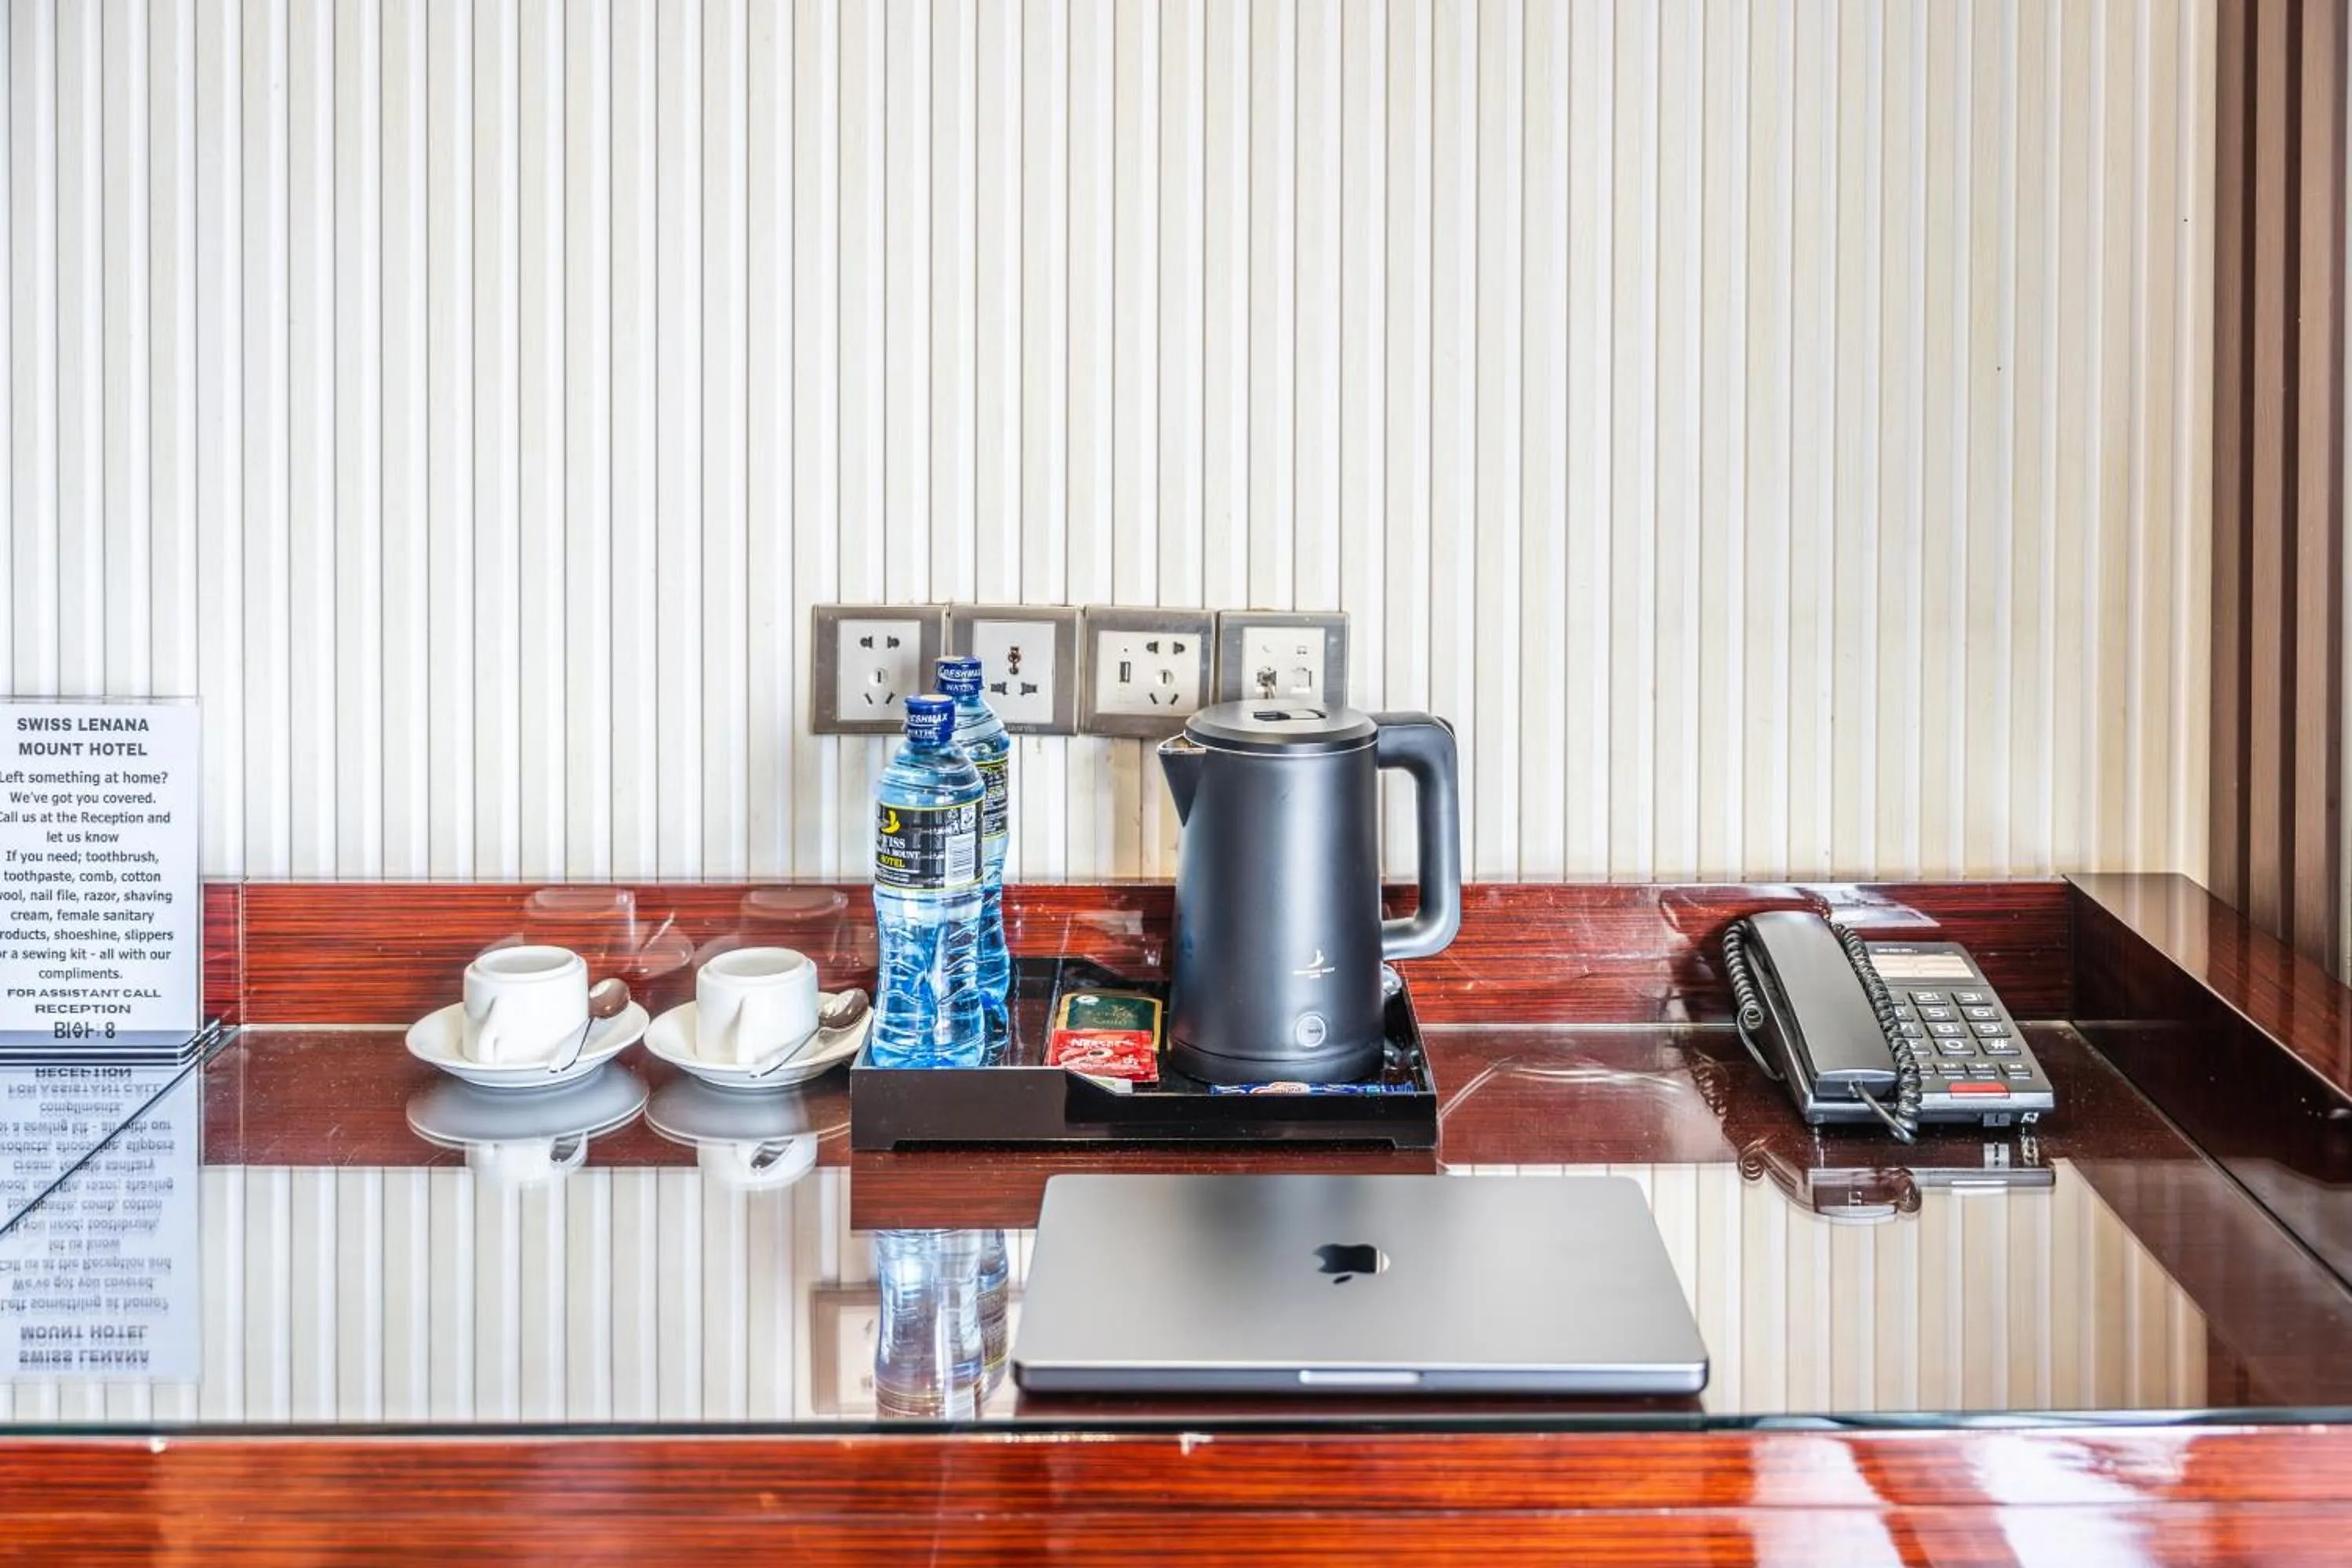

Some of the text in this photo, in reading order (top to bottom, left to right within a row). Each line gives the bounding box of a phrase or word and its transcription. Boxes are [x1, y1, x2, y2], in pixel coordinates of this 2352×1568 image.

[17, 717, 149, 731] SWISS LENANA
[19, 742, 147, 756] MOUNT HOTEL
[0, 771, 168, 786] Left something at home?
[9, 792, 156, 806] We've got you covered.
[22, 814, 36, 823] us
[41, 812, 53, 822] at
[56, 811, 77, 822] the
[82, 812, 143, 825] Reception
[147, 811, 170, 823] and
[47, 831, 119, 843] let us know
[6, 849, 158, 864] If you need; toothbrush,
[4, 870, 161, 884] toothpaste, comb, cotton
[31, 889, 53, 901] nail
[56, 889, 79, 903] file,
[84, 892, 119, 903] razor,
[124, 890, 172, 904] shaving
[10, 909, 154, 924] cream, female sanitary
[0, 928, 173, 943] roducts, shoeshine, slippers
[11, 950, 18, 959] a
[22, 948, 66, 962] sewing
[71, 949, 86, 960] kit
[100, 949, 114, 960] all
[118, 949, 146, 960] with
[151, 951, 171, 960] our
[38, 967, 122, 982] compliments.
[7, 989, 35, 997] FOR
[34, 1004, 131, 1014] RECEPTION
